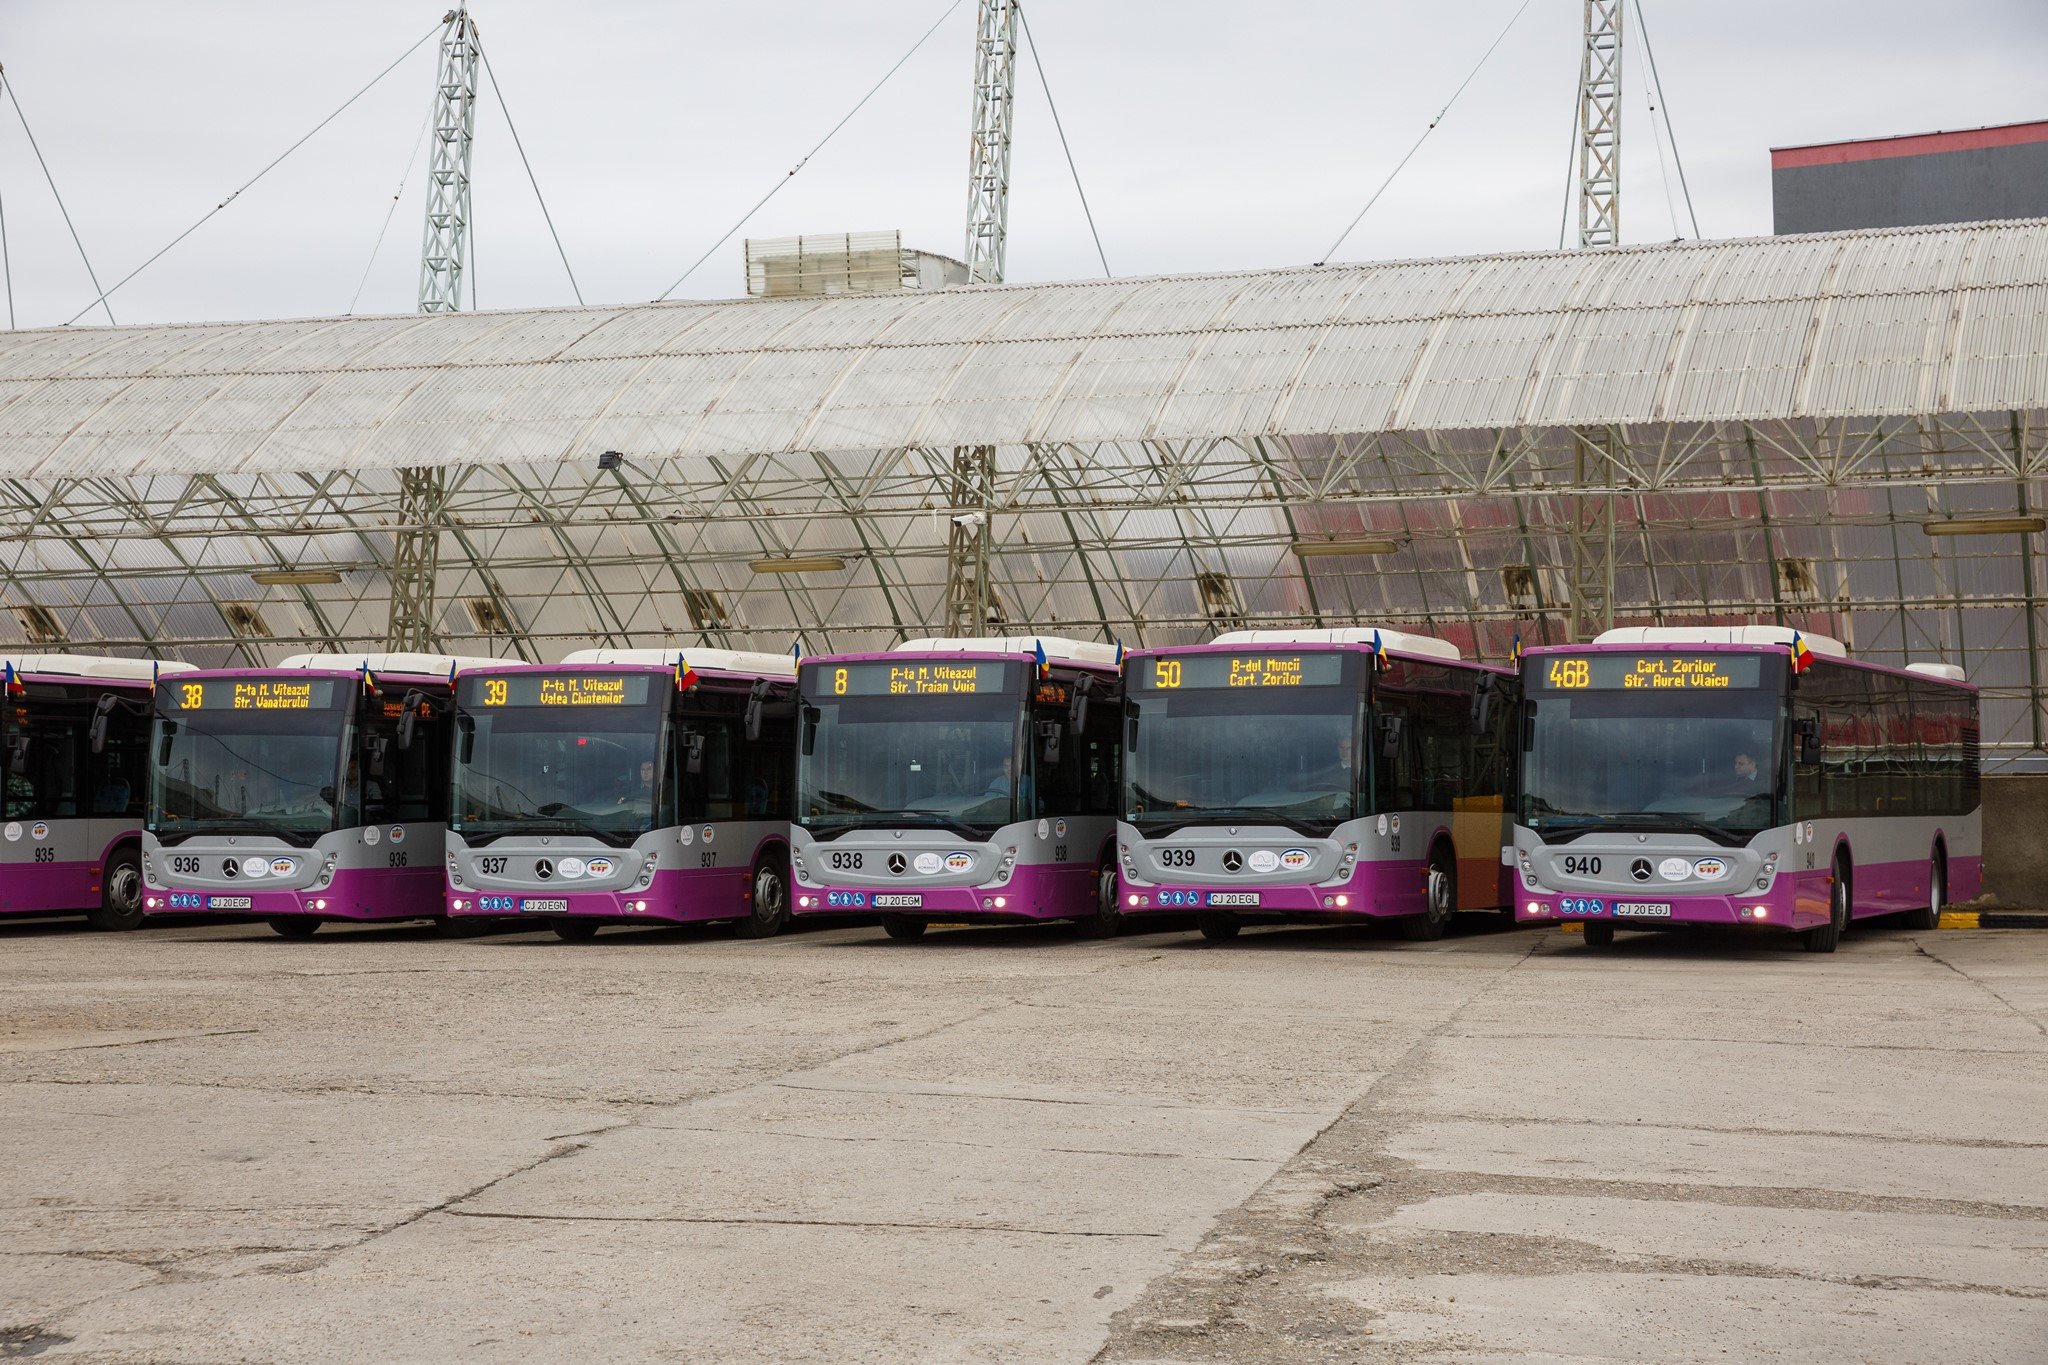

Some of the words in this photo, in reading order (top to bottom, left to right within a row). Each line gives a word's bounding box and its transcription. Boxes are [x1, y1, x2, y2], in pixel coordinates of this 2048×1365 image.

[891, 667, 915, 680] P-ta
[918, 667, 930, 680] M.
[934, 666, 977, 679] Viteazul
[1232, 659, 1262, 673] B-dul
[1266, 658, 1300, 672] Muncii
[1637, 659, 1668, 673] Cart.
[1672, 659, 1717, 673] Zorilor
[834, 668, 848, 695] 8
[1155, 661, 1181, 688] 50
[1229, 673, 1258, 686] Cart.
[1262, 672, 1303, 686] Zorilor
[1549, 660, 1590, 688] 46B
[1624, 674, 1649, 687] Str.
[1653, 674, 1685, 687] Aurel
[1691, 673, 1729, 687] Vlaicu
[235, 684, 257, 696] P-ta
[259, 684, 270, 696] M.
[273, 683, 310, 696] Viteazul
[484, 680, 508, 705] 39
[542, 680, 565, 692] P-ta
[568, 679, 580, 692] M.
[583, 678, 623, 691] Viteazul
[890, 680, 912, 694] Str.
[916, 680, 949, 693] Traian
[952, 680, 976, 692] Vuia
[180, 684, 203, 709] 38
[234, 696, 253, 709] Str.
[256, 696, 309, 709] Vanatorului
[540, 692, 568, 705] Valea
[571, 692, 625, 704] Chintenilor
[35, 847, 54, 862] 935
[389, 851, 407, 867] 936
[701, 852, 717, 867] 937
[832, 852, 863, 869] 938
[1162, 849, 1195, 867] 939
[174, 857, 200, 873] 936
[482, 857, 508, 874] 937
[1565, 856, 1602, 875] 940
[1212, 895, 1224, 904] CJ
[1226, 895, 1237, 904] 20
[1238, 895, 1258, 904] EGL
[1618, 905, 1631, 915] CJ
[1634, 905, 1646, 915] 20
[1648, 905, 1668, 915] EGJ
